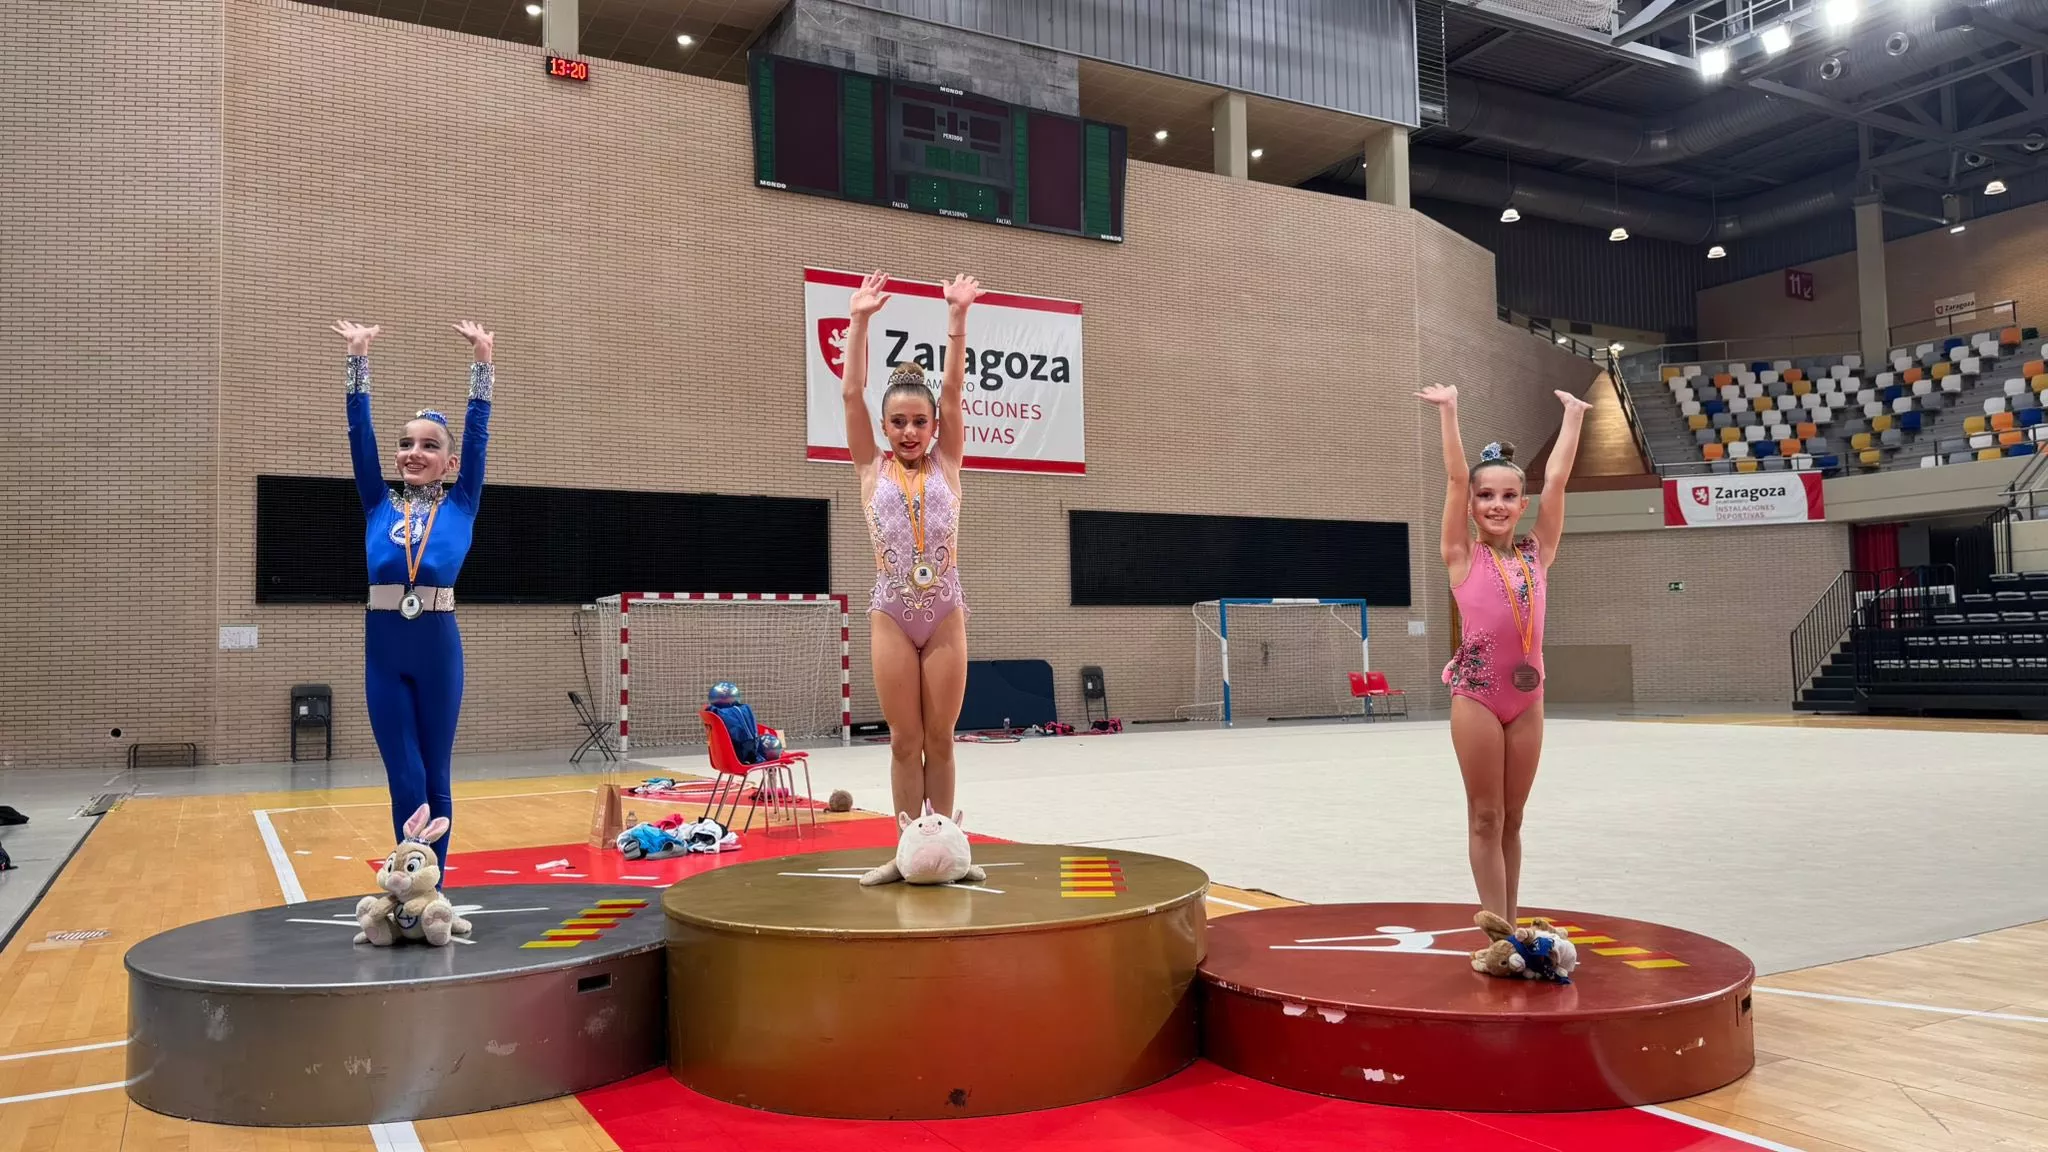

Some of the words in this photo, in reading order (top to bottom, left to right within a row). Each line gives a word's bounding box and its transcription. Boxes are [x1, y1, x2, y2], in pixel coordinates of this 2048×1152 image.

[550, 58, 586, 79] 13:20
[940, 86, 964, 96] MONDO
[760, 180, 787, 189] MONDO
[892, 201, 909, 209] FALTAS
[1714, 486, 1786, 502] Zaragoza
[1715, 503, 1776, 512] INSTALACIONES
[1716, 511, 1766, 520] DEPORTIVAS
